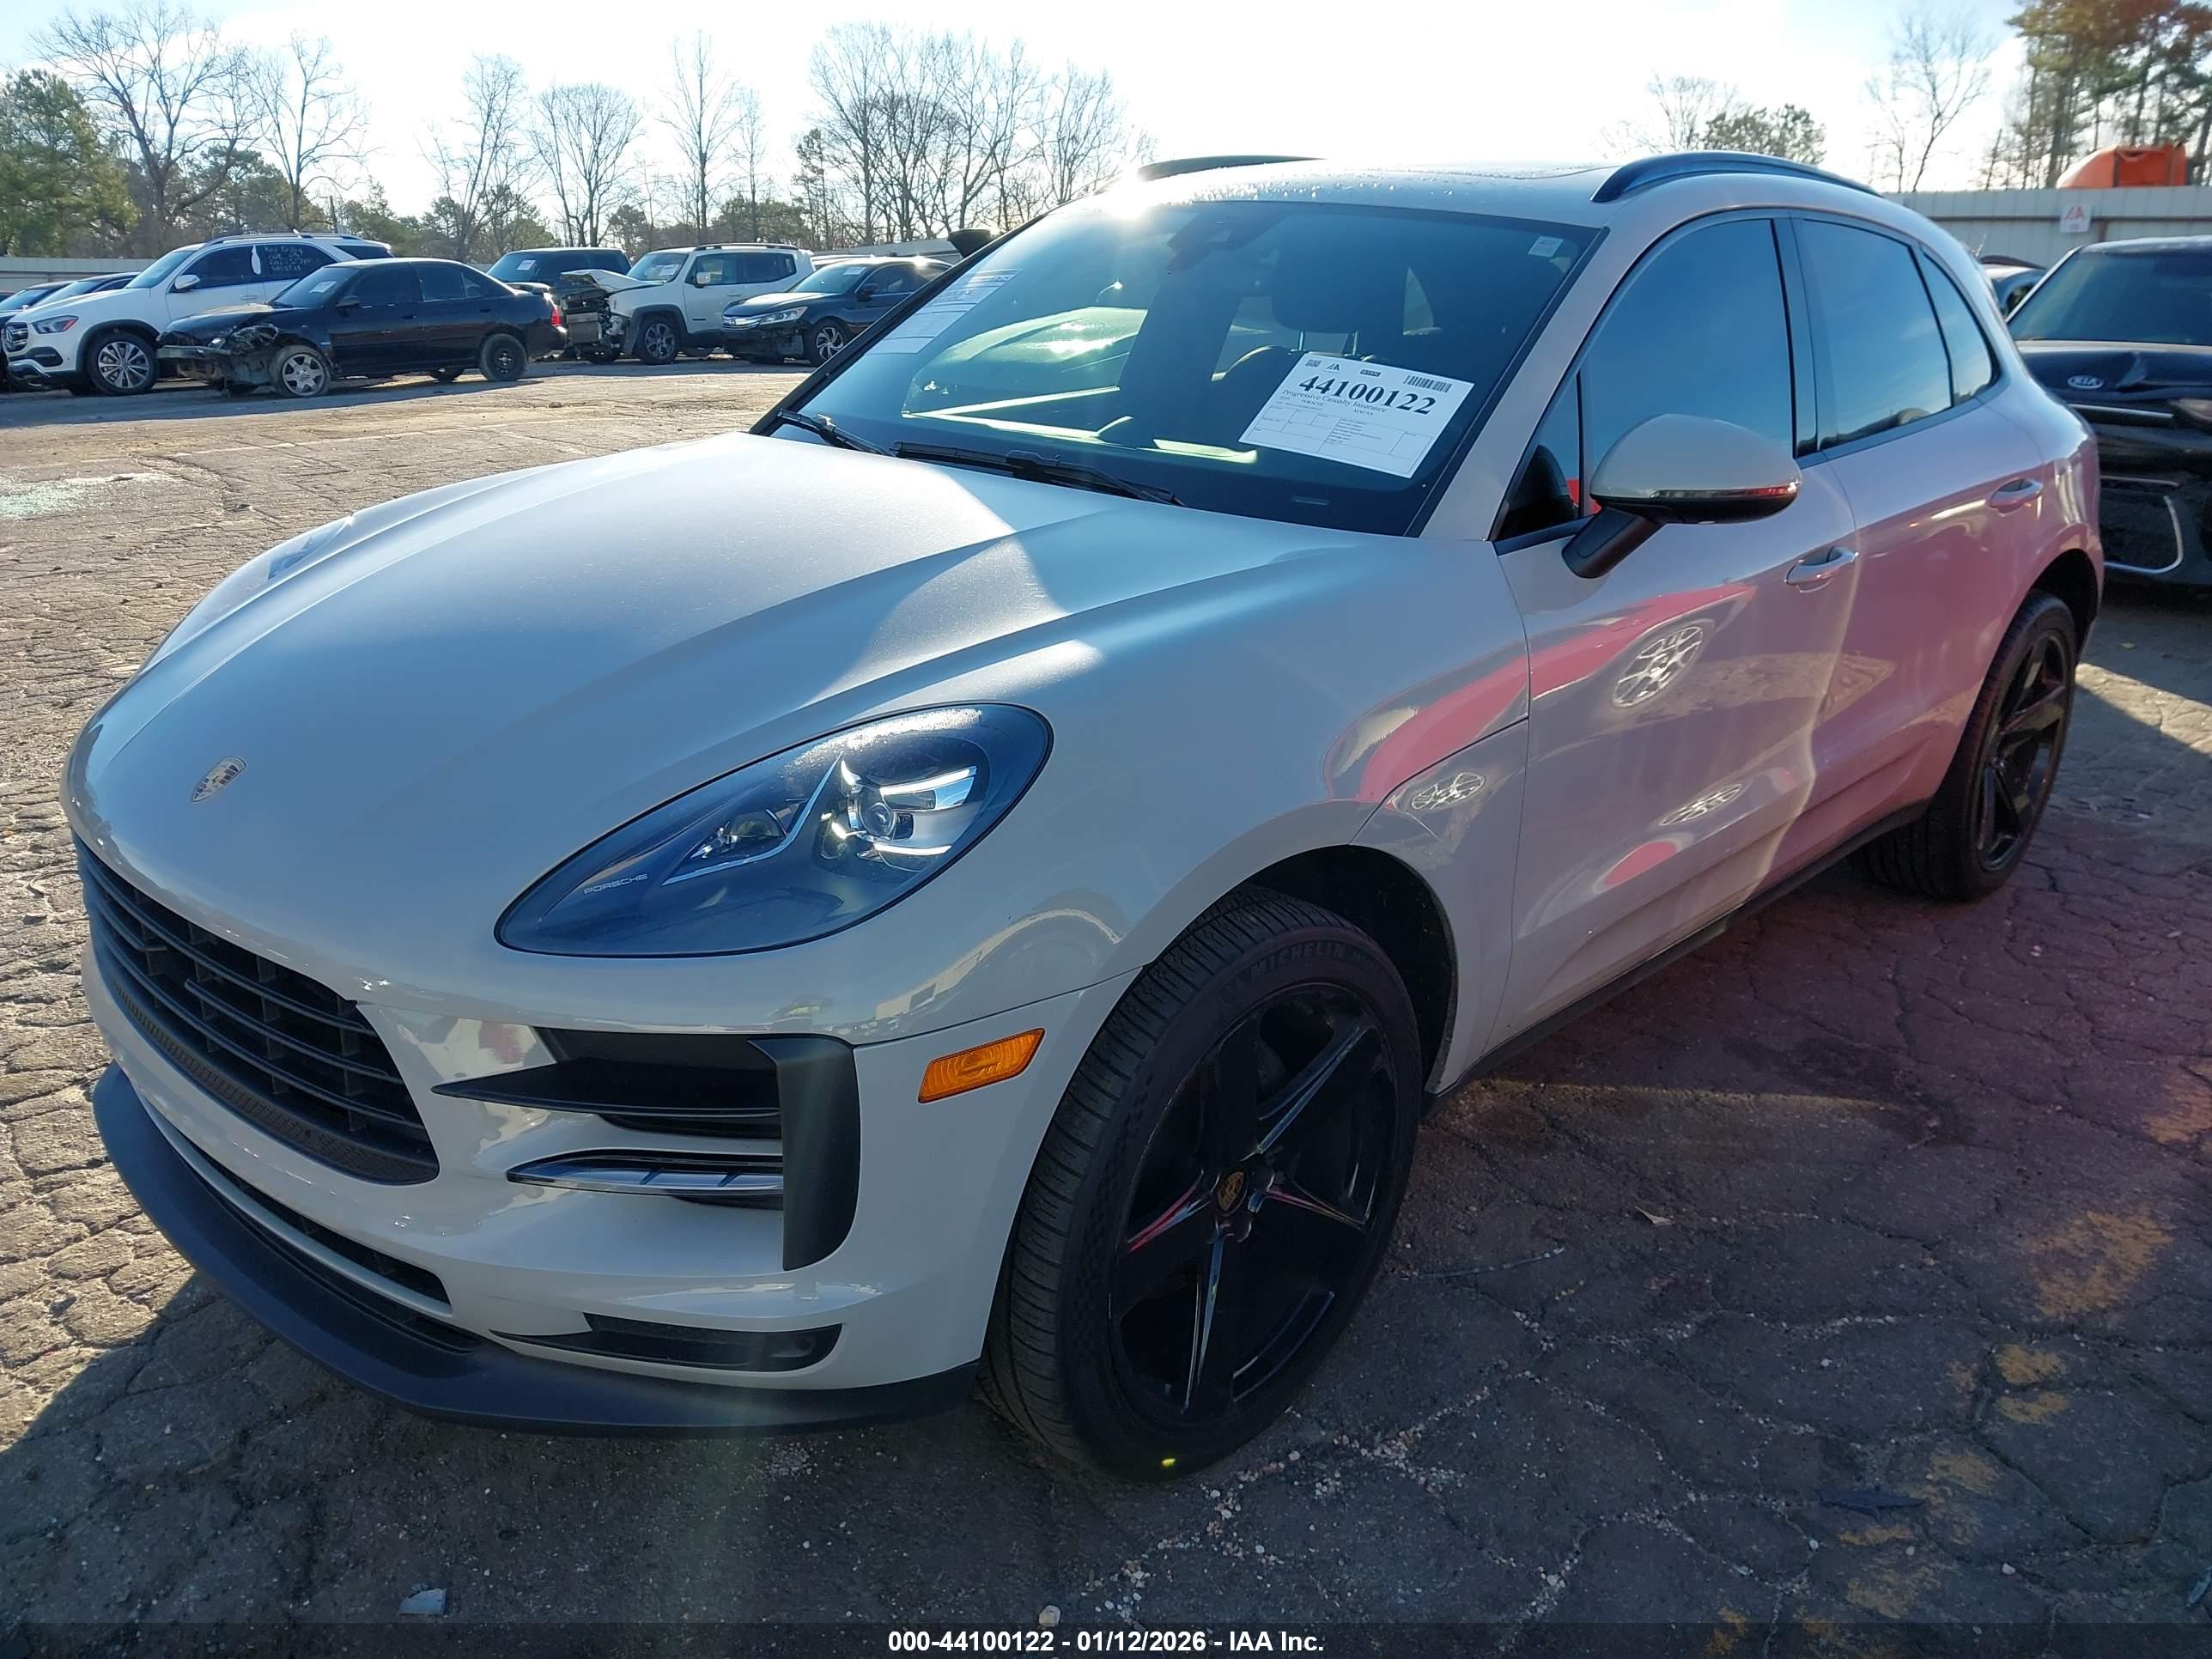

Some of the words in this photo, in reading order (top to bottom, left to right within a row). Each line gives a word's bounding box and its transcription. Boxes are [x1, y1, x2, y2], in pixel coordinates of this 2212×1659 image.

[1282, 389, 1322, 401] Progressive
[1322, 395, 1352, 406] Casualty
[1352, 400, 1388, 413] Insurance
[1298, 375, 1436, 415] 44100122
[584, 873, 649, 895] PORSCHE
[1250, 942, 1345, 981] MICHELIN
